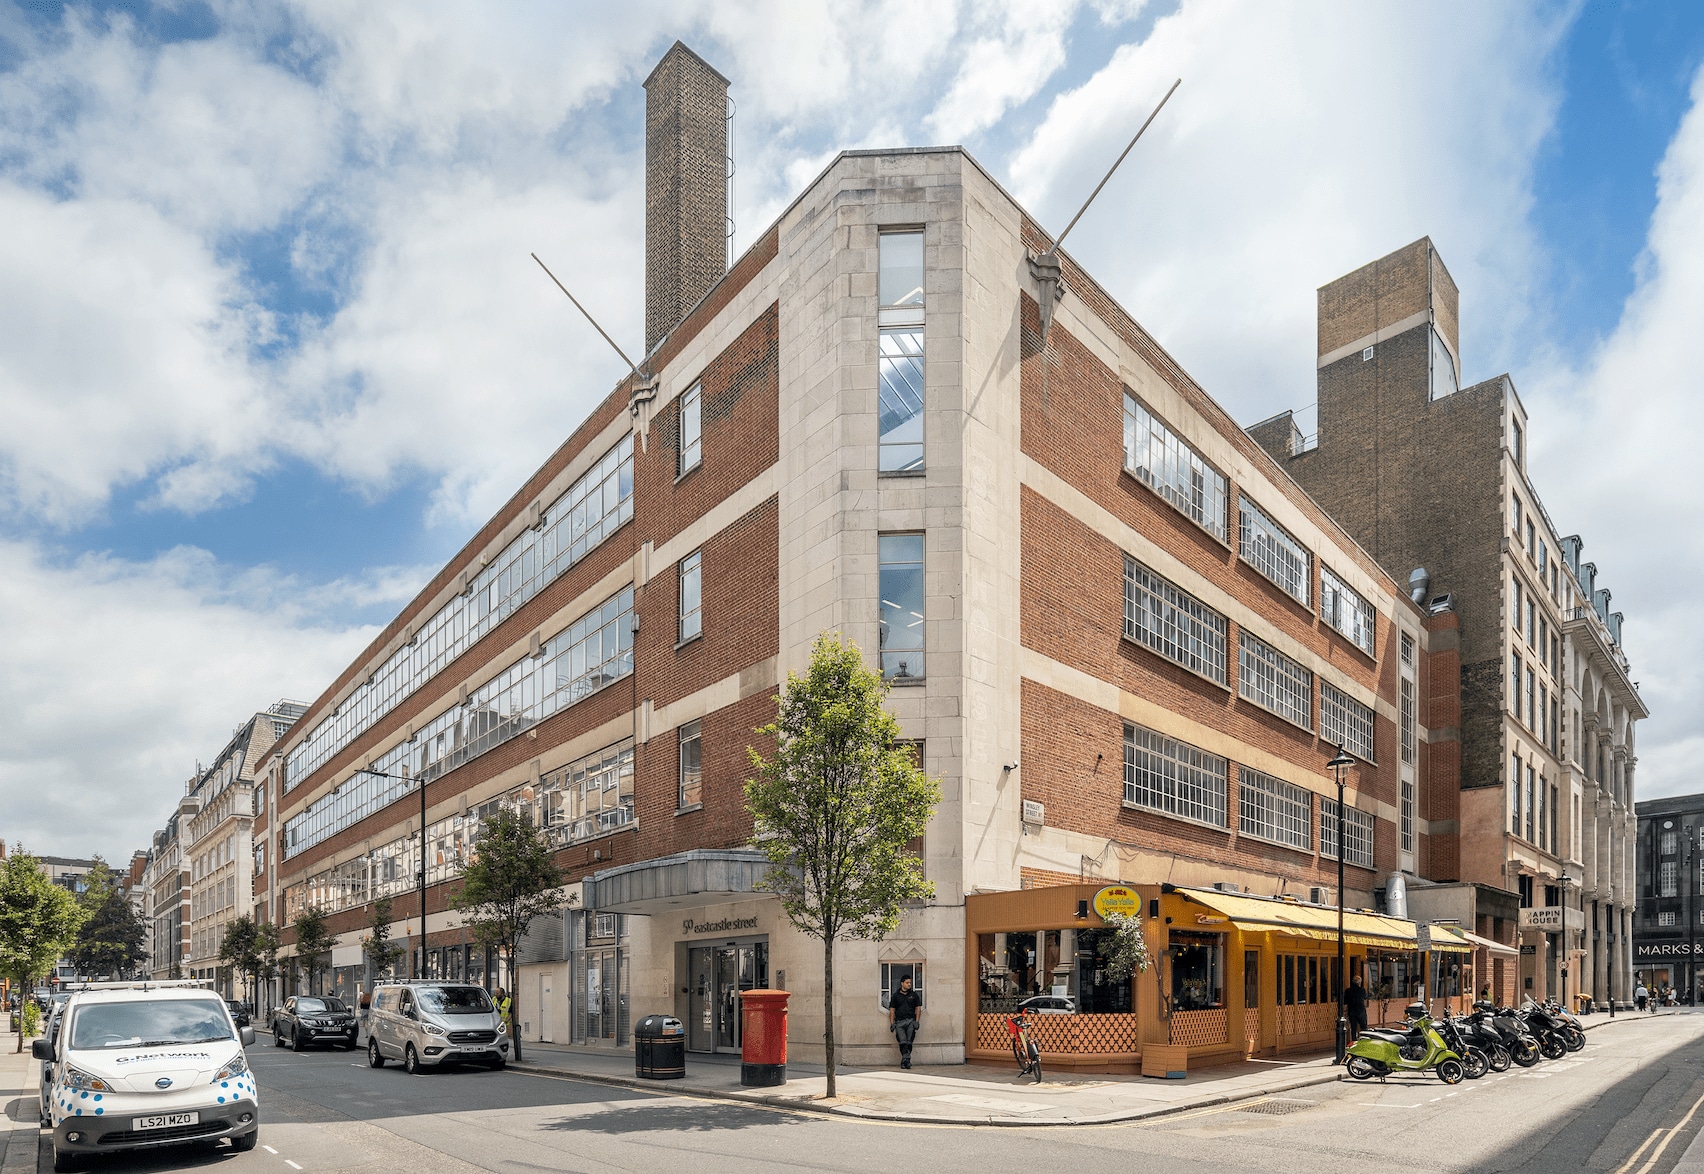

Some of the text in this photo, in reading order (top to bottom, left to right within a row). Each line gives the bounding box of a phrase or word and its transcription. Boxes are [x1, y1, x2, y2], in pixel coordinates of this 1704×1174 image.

[1025, 809, 1038, 817] STREET
[682, 916, 758, 935] 50 eastcastle street
[1638, 943, 1704, 956] MARKS &
[140, 1114, 191, 1128] LS21 MZO
